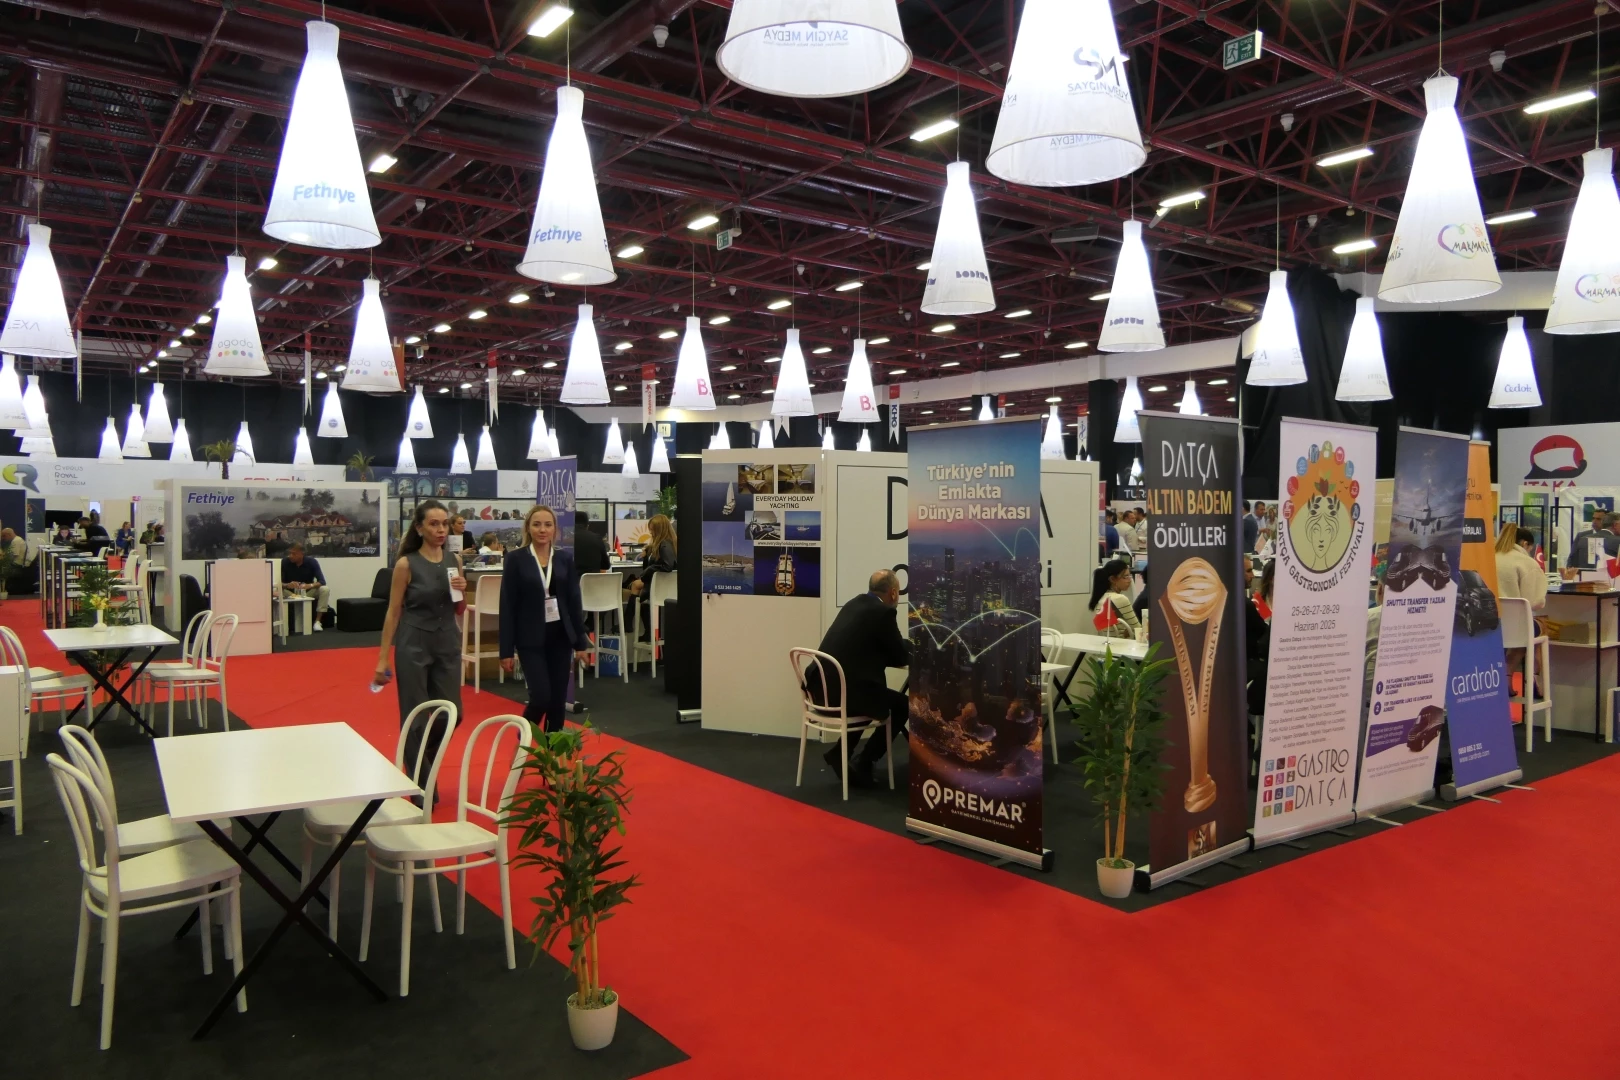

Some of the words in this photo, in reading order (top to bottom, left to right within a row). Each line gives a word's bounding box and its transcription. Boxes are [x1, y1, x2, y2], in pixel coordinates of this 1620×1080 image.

[1067, 81, 1107, 92] SAYGIN
[1107, 86, 1129, 100] MEDY
[293, 182, 356, 205] Fethiye
[533, 226, 583, 245] Fethiye
[217, 338, 254, 349] agoda
[54, 464, 84, 472] CYPRUS
[1161, 440, 1219, 486] DATÇA
[54, 479, 86, 487] TOURISM
[541, 469, 575, 497] DATÇA
[938, 483, 1001, 500] Emlakta
[187, 491, 235, 507] Fethiye
[1124, 489, 1146, 499] TUR
[1147, 489, 1184, 515] ALTIN
[1187, 489, 1232, 515] BADEM
[917, 505, 964, 522] Dünya
[968, 503, 1031, 520] Markası
[1291, 604, 1340, 616] 25-26-27-28-29
[1407, 597, 1428, 606] TRANSFER
[1294, 621, 1319, 632] Haziran
[1319, 620, 1336, 630] 2025
[1451, 663, 1500, 695] cardrob
[1297, 748, 1349, 778] GASTRO
[1295, 777, 1347, 810] DATÇA
[943, 787, 1023, 823] PREMAR
